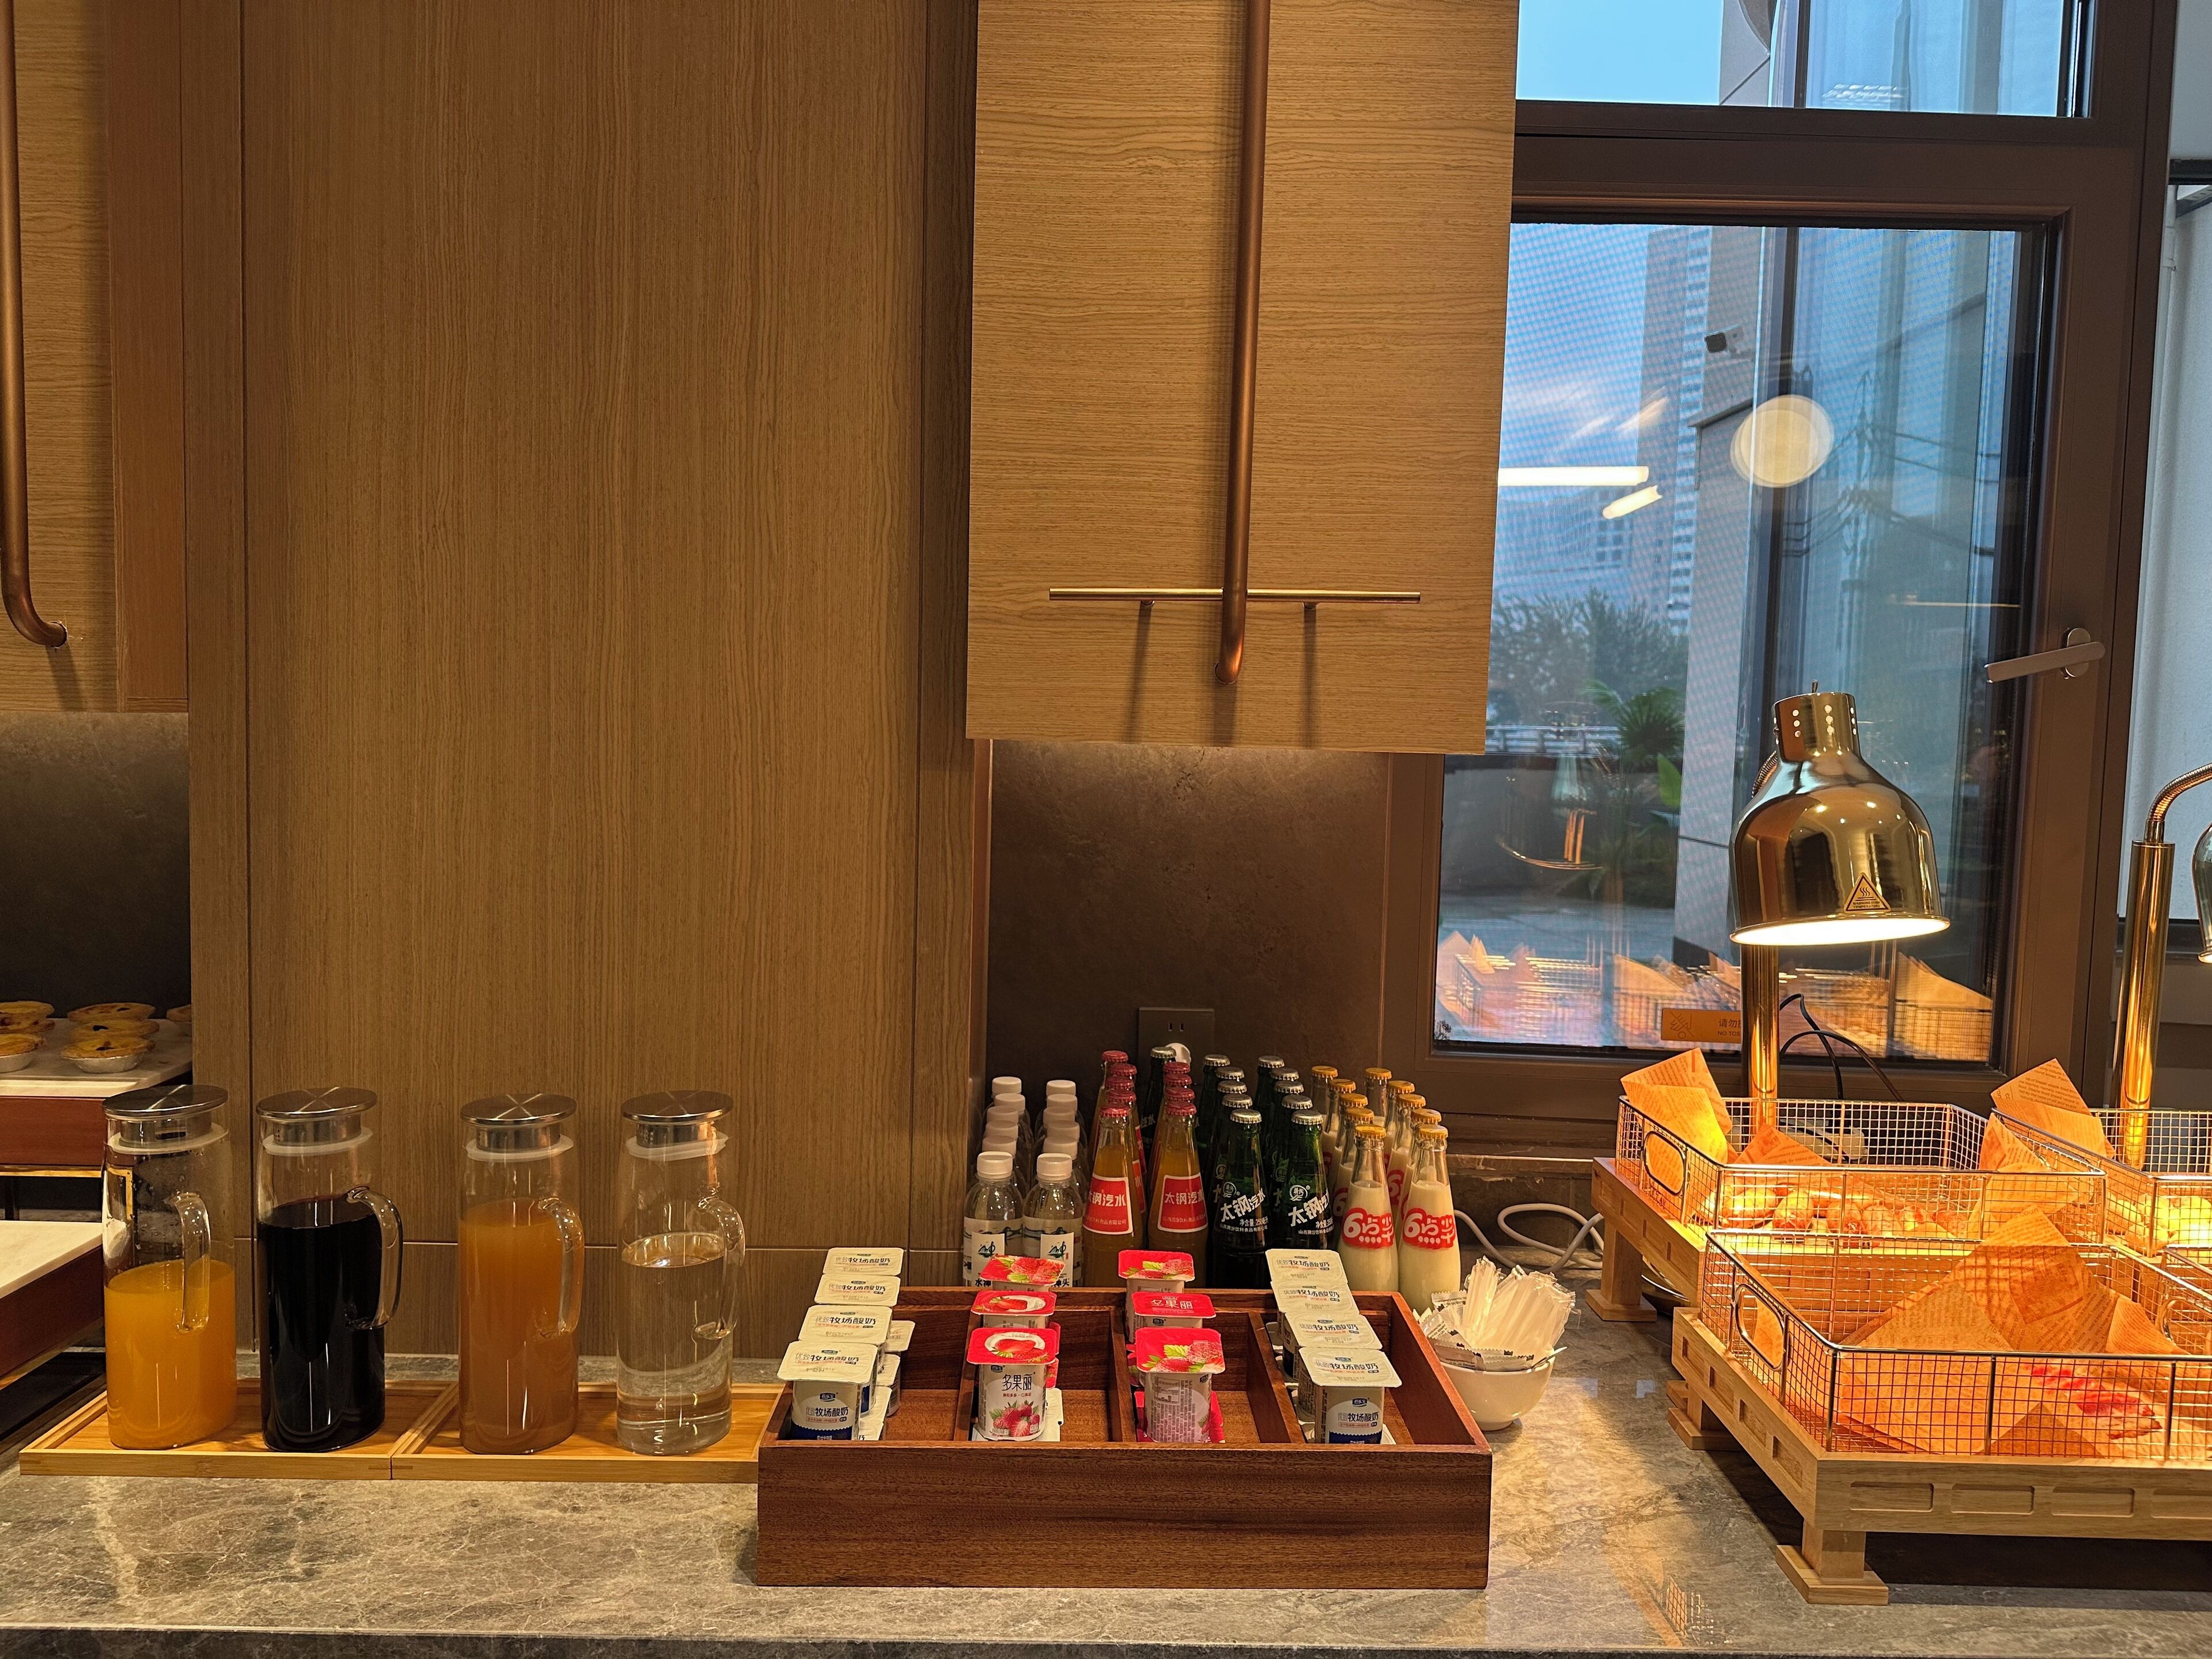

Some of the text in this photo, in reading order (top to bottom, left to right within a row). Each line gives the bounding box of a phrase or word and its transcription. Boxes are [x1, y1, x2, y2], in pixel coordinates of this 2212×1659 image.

[1220, 1188, 1266, 1222] 太钢汽水
[1343, 1212, 1394, 1244] 6点半
[1403, 1213, 1455, 1244] 6点半
[1002, 1373, 1033, 1391] 多果丽
